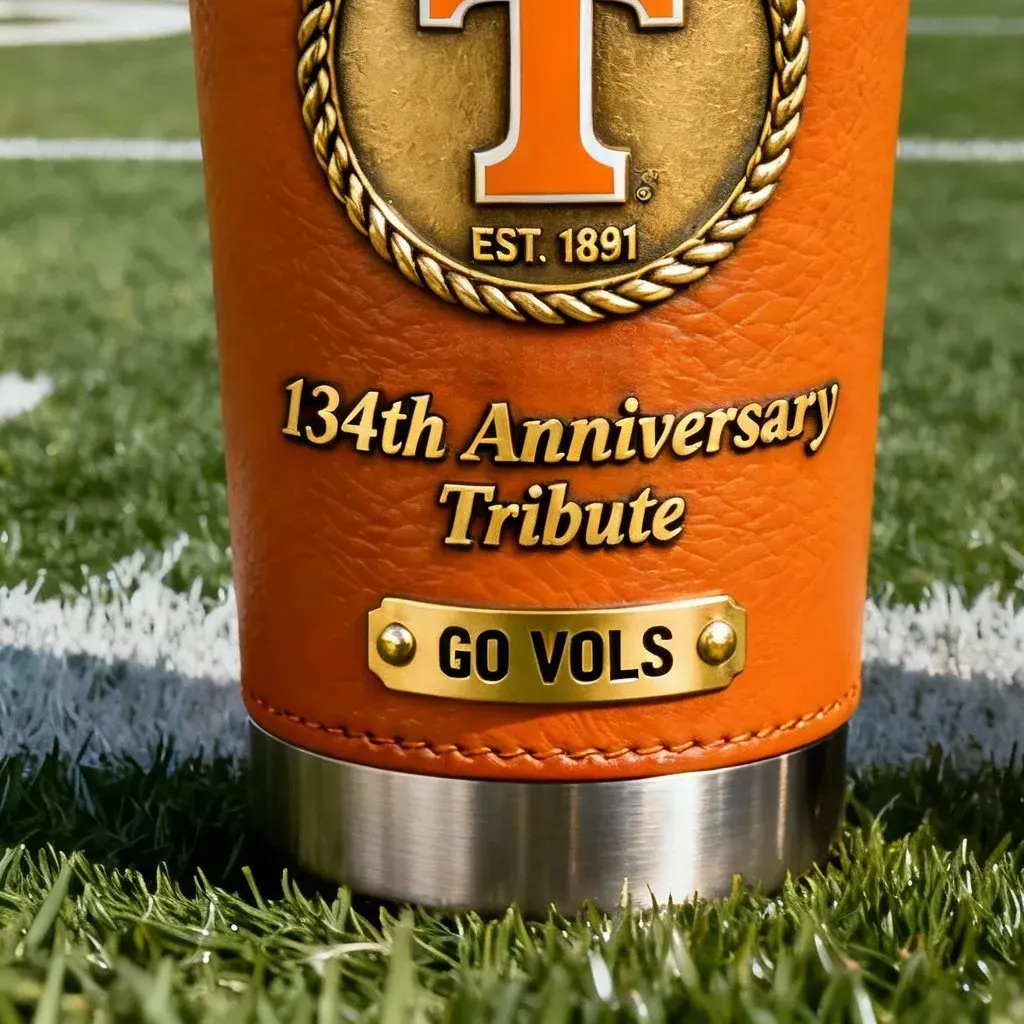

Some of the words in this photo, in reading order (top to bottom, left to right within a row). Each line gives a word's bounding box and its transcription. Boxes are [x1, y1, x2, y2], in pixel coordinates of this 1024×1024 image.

[472, 226, 547, 263] EST.
[559, 224, 637, 263] 1891
[282, 378, 445, 460] 134th
[460, 383, 839, 463] Anniversary
[440, 482, 686, 547] Tribute
[438, 626, 510, 685] GO
[532, 625, 674, 685] VOLS
